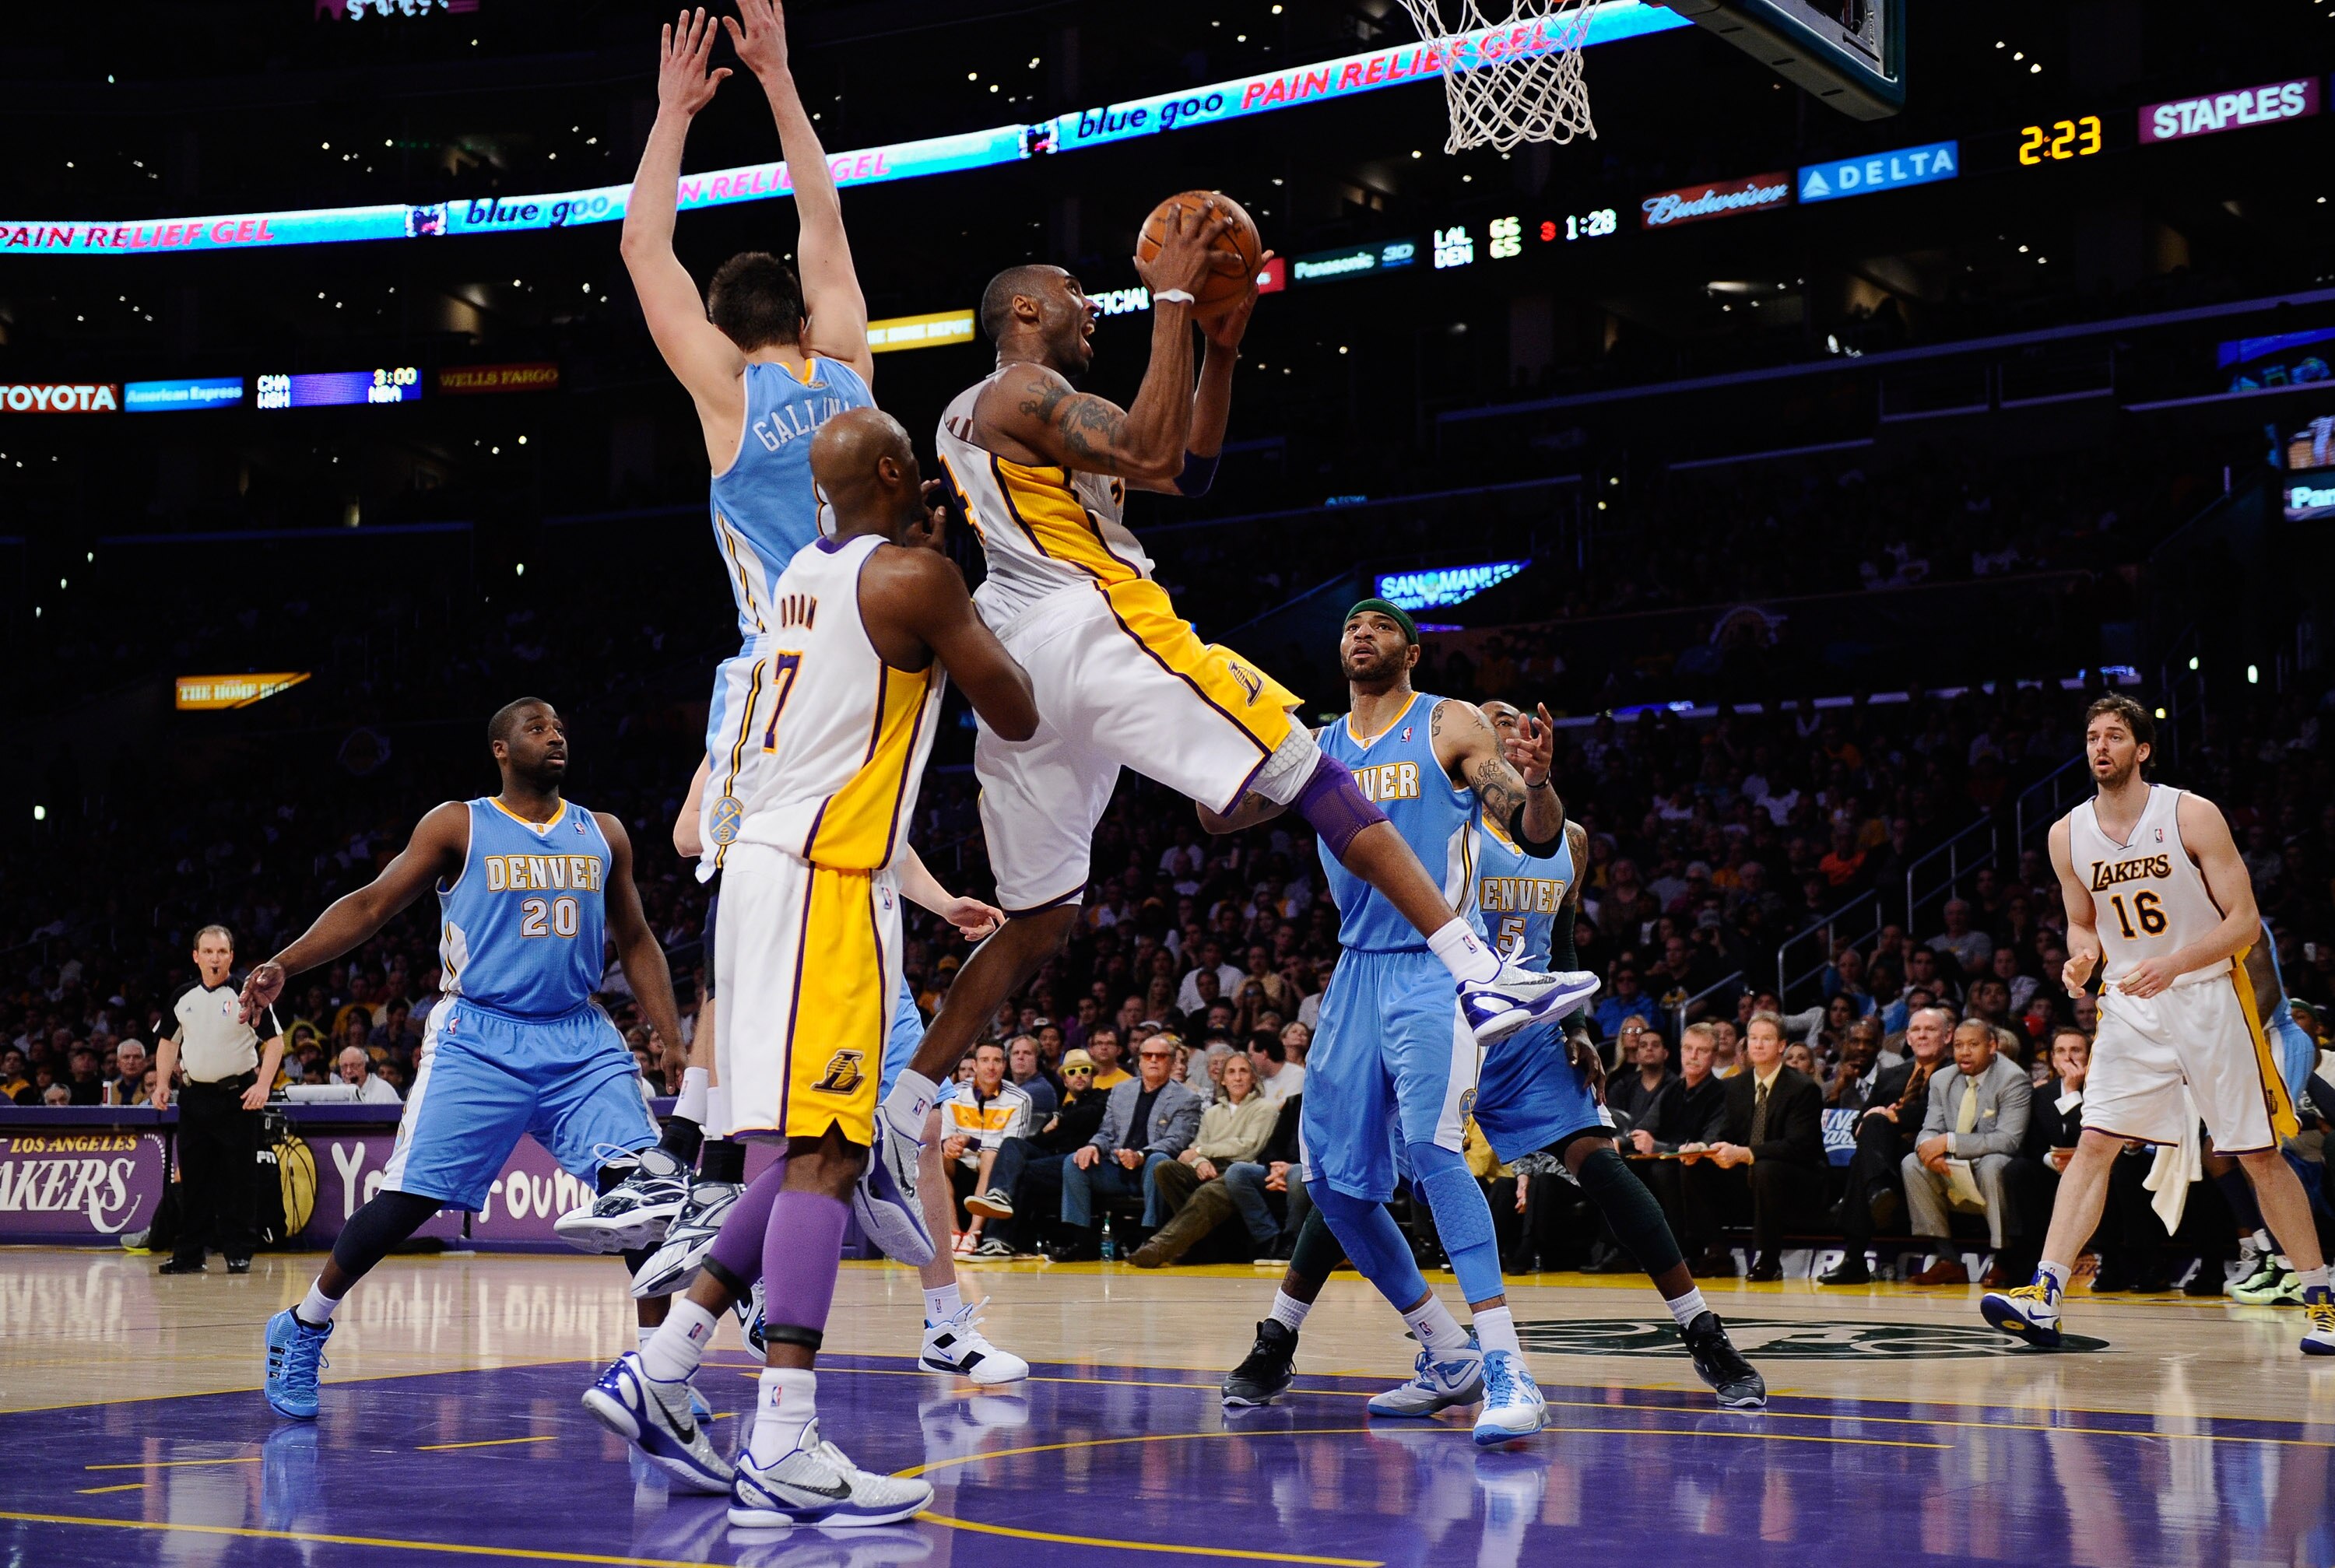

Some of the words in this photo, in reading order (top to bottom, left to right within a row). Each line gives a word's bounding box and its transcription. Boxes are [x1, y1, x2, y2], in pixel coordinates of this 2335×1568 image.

[1241, 68, 1331, 109] PAIN
[1337, 38, 1468, 89] RELIEF
[1480, 21, 1550, 58] GEL
[1077, 107, 1147, 139] blue
[1159, 93, 1224, 130] goo
[2153, 82, 2306, 139] STAPLES
[2019, 115, 2102, 166] 2:23
[830, 153, 891, 182] GEL
[1838, 148, 1954, 191] DELTA
[466, 197, 539, 224] blue
[546, 195, 608, 229] goo
[1642, 181, 1789, 226] Budweiser
[83, 223, 204, 249] RELIEF
[209, 219, 275, 244] GEL
[1433, 226, 1473, 249] LAL
[1540, 220, 1557, 243] 3
[1565, 208, 1617, 241] 1:28
[1294, 251, 1376, 281] Panasonic
[1381, 244, 1415, 262] 3D
[1433, 244, 1474, 269] DEN
[1488, 235, 1522, 260] 65
[126, 387, 189, 404] American
[190, 384, 243, 403] Express
[440, 370, 498, 388] WELLS
[500, 367, 559, 386] FARGO
[1381, 574, 1425, 599] SAN
[180, 684, 211, 702] THE
[762, 647, 804, 755] 7
[485, 854, 602, 893] DENVER
[2091, 853, 2172, 893] LAKERS
[1480, 875, 1568, 914] ENVER
[521, 896, 579, 938] 20
[2109, 888, 2170, 941] 16
[1498, 914, 1526, 955] 5
[10, 1137, 45, 1154] LOS
[47, 1134, 138, 1153] ANGELES
